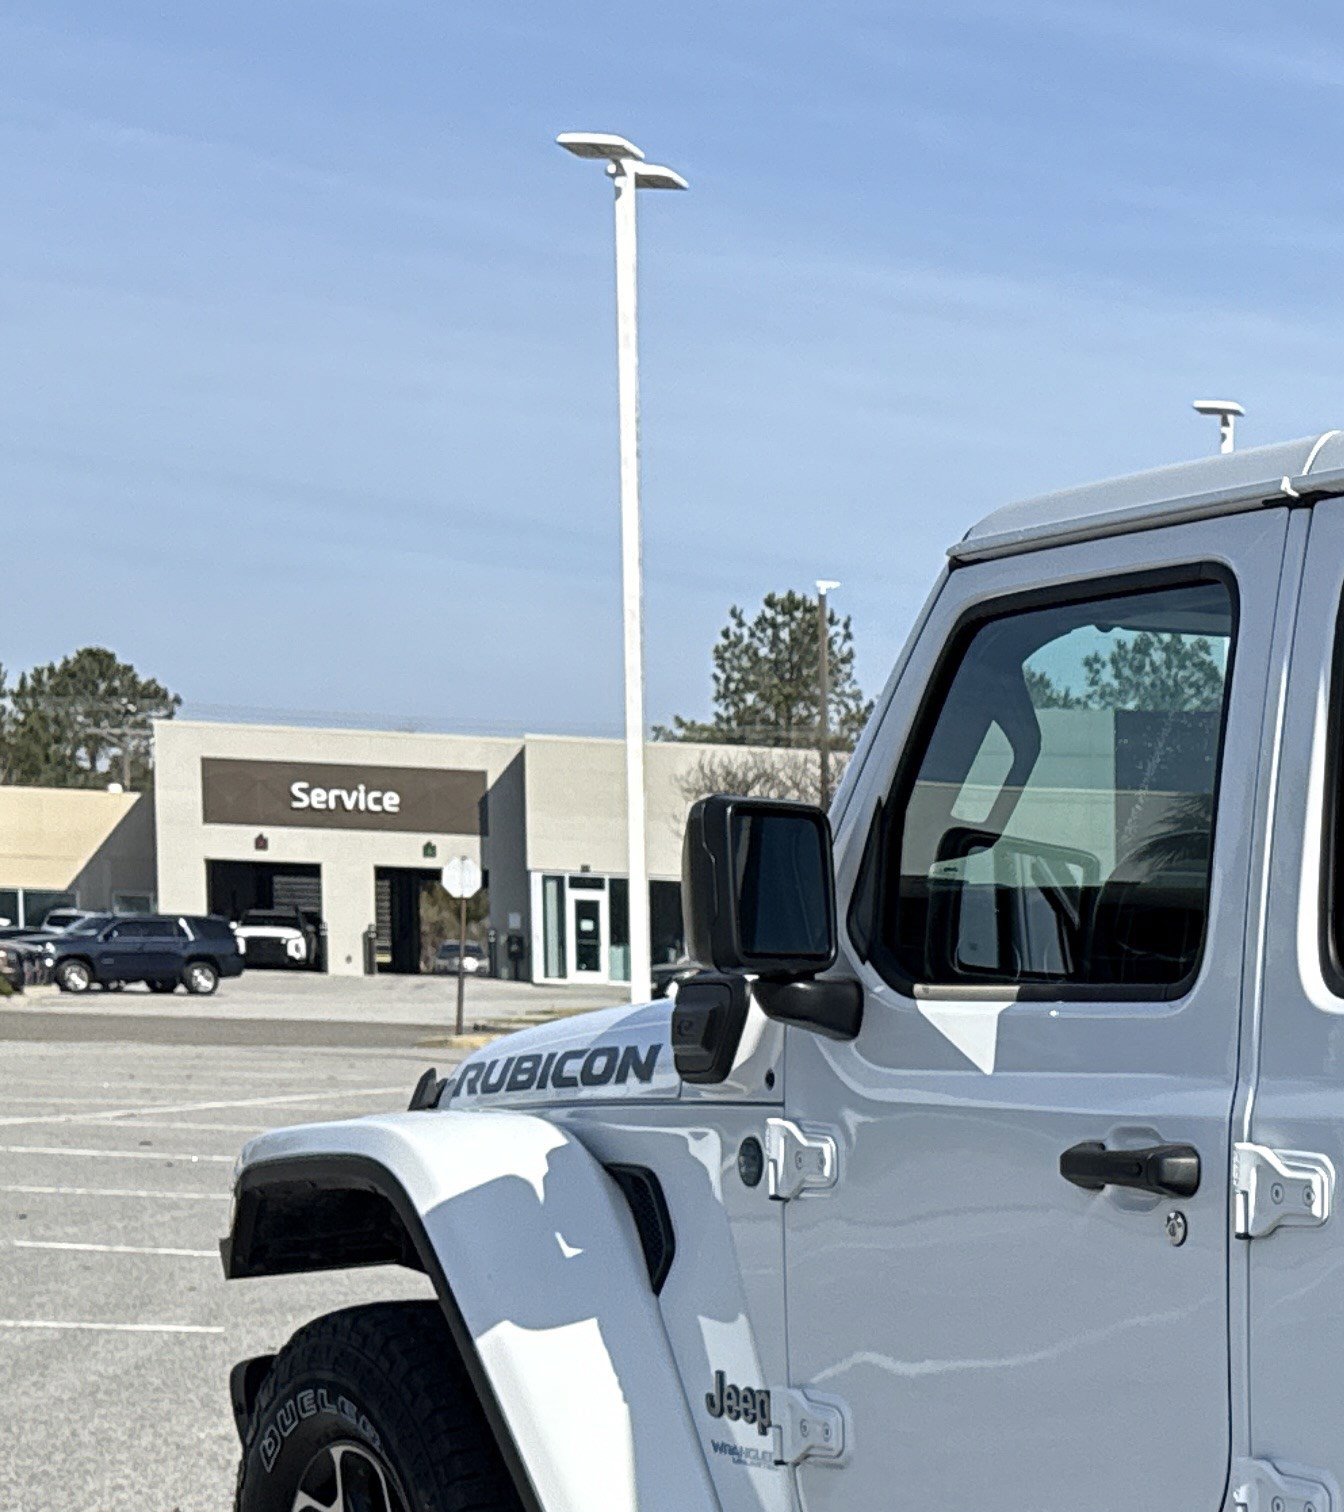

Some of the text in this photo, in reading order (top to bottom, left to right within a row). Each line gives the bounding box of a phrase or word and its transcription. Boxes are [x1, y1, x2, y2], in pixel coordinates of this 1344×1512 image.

[291, 781, 400, 813] Service
[451, 1043, 664, 1099] RUBICON
[259, 1388, 382, 1474] DUELER
[705, 1369, 772, 1436] Jeep
